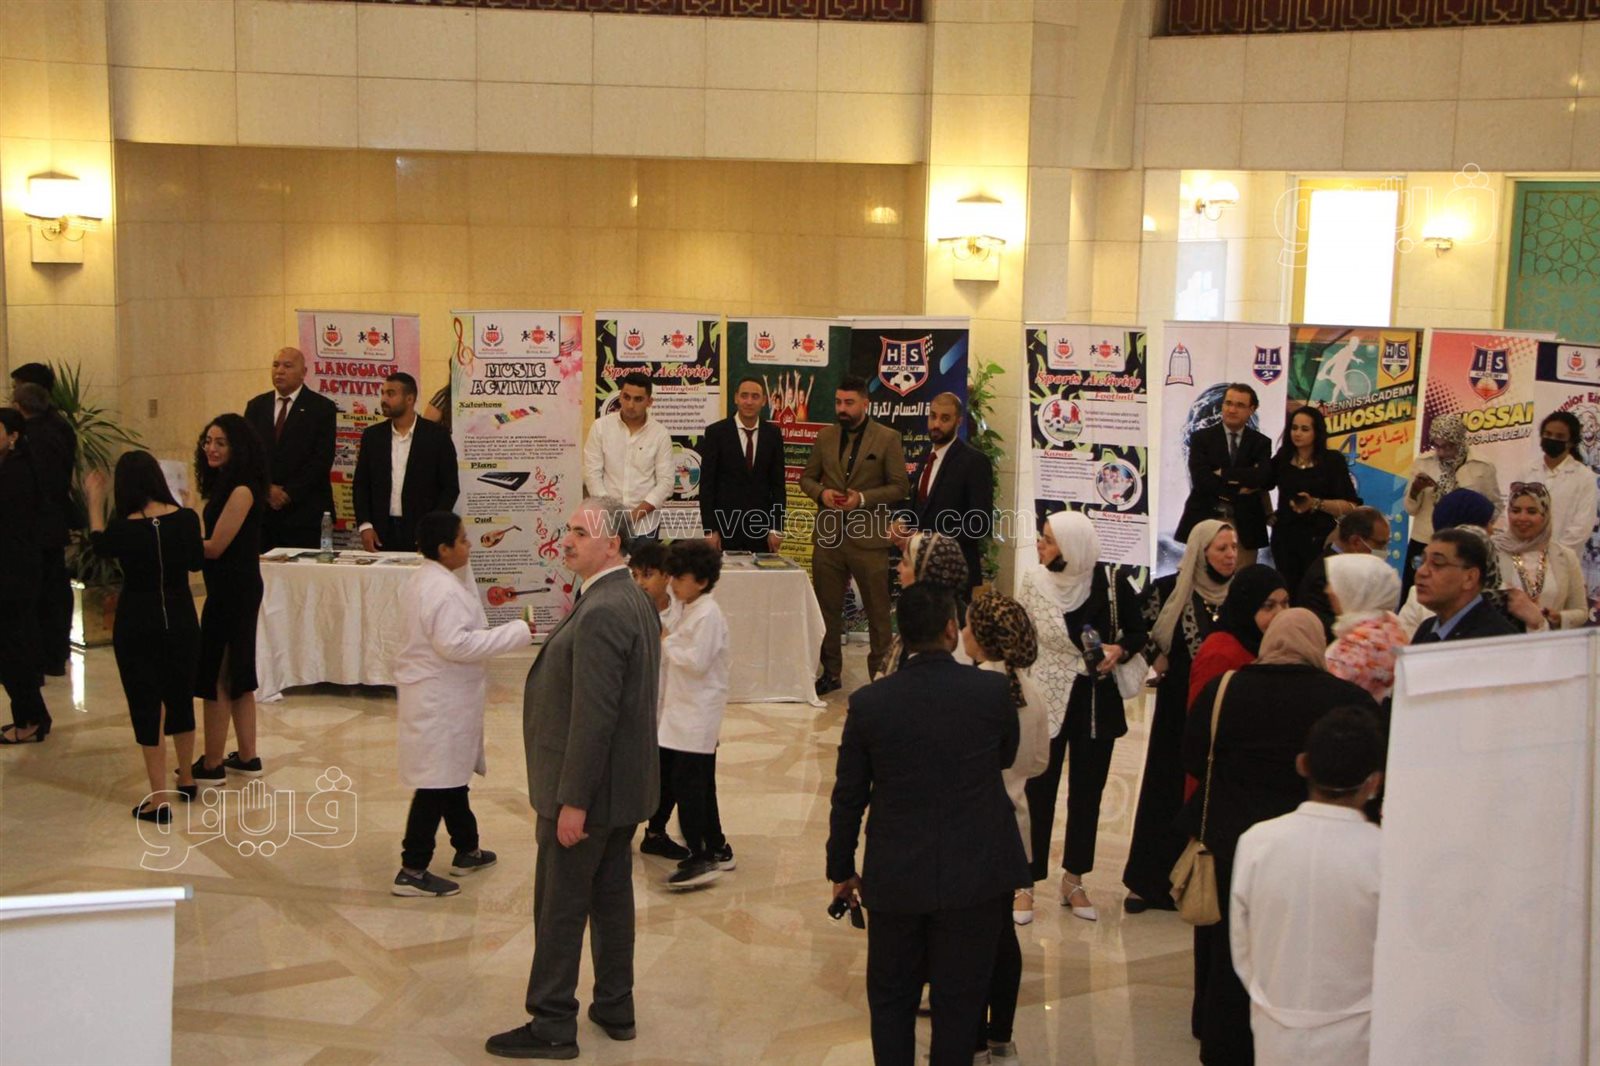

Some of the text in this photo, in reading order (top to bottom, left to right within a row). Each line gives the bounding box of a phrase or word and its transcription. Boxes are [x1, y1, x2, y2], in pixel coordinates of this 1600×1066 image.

[484, 362, 546, 378] MUSIC
[601, 364, 713, 380] Sports Activity
[319, 379, 384, 396] ACTIVIT
[470, 379, 560, 396] ACTIVITY
[1034, 371, 1142, 390] Sports Activity
[1095, 392, 1135, 400] Football
[1364, 384, 1415, 405] ACADEMY
[342, 414, 378, 422] English
[872, 402, 891, 418] لكرة
[891, 402, 924, 424] الحسام
